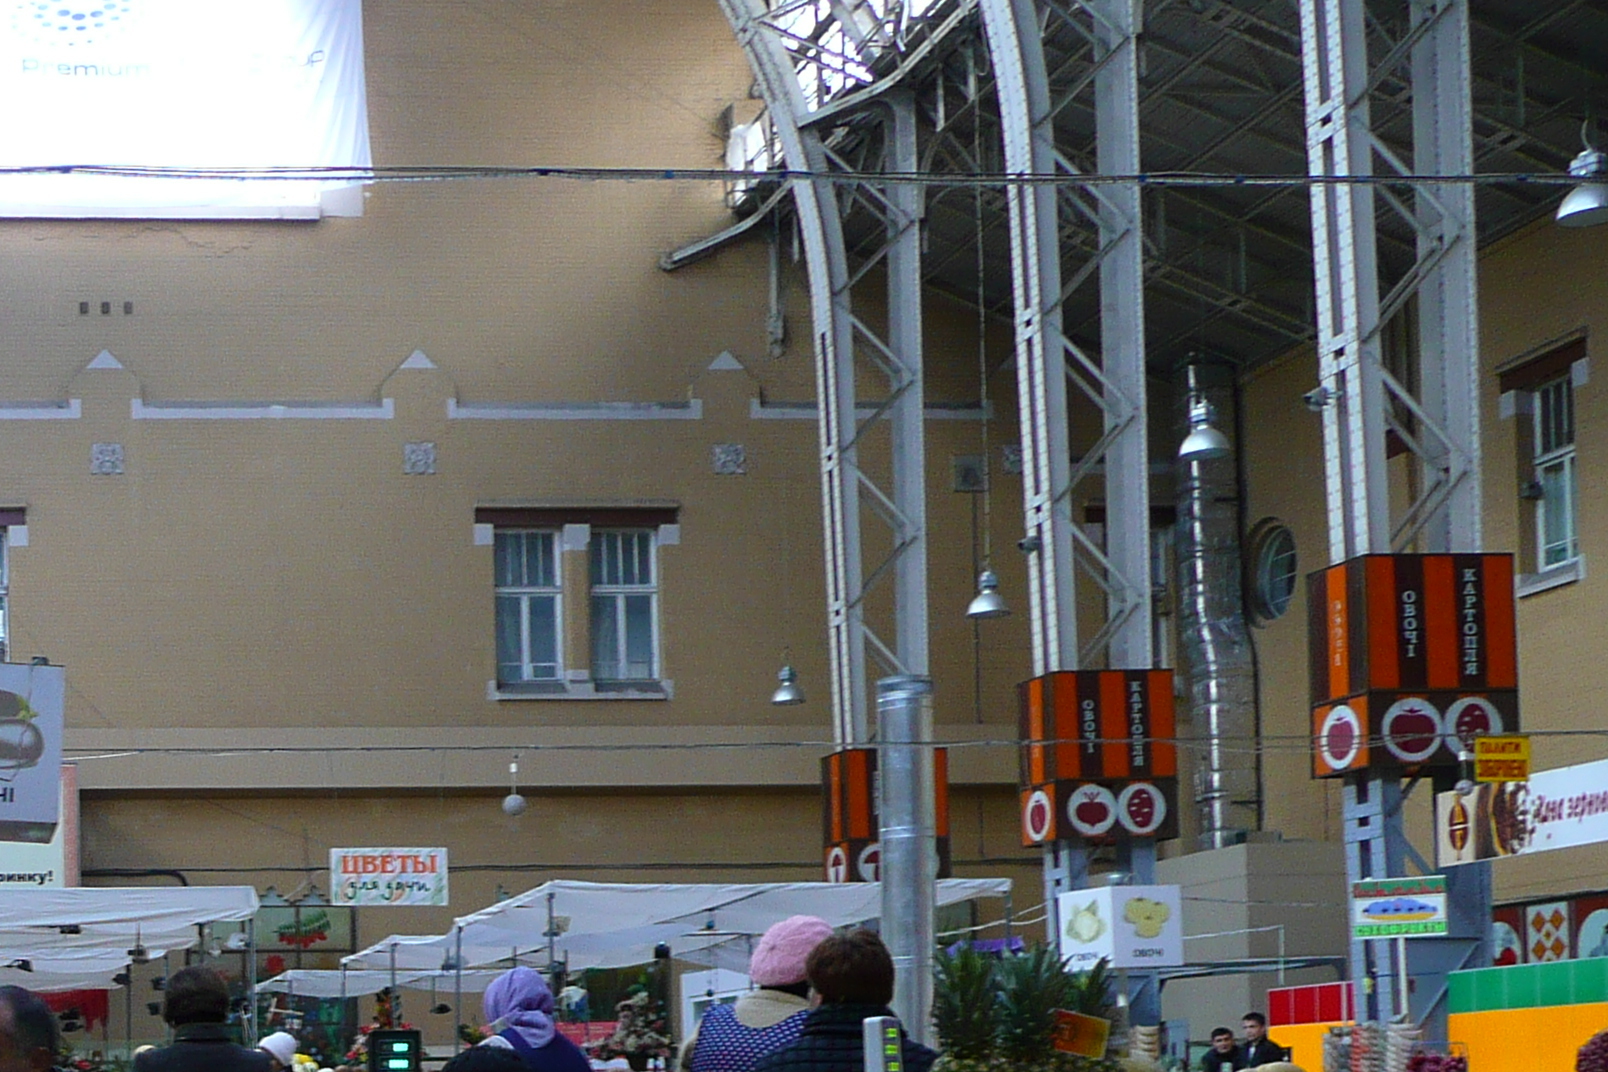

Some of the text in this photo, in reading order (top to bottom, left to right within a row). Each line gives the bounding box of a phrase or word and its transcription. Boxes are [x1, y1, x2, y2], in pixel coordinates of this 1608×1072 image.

[1401, 590, 1418, 658] ОВОЧІ
[1463, 568, 1479, 675] КАРТОПЛЯ
[1082, 700, 1096, 753] ОВОЧІ
[341, 855, 438, 874] ЦВЕТЫ
